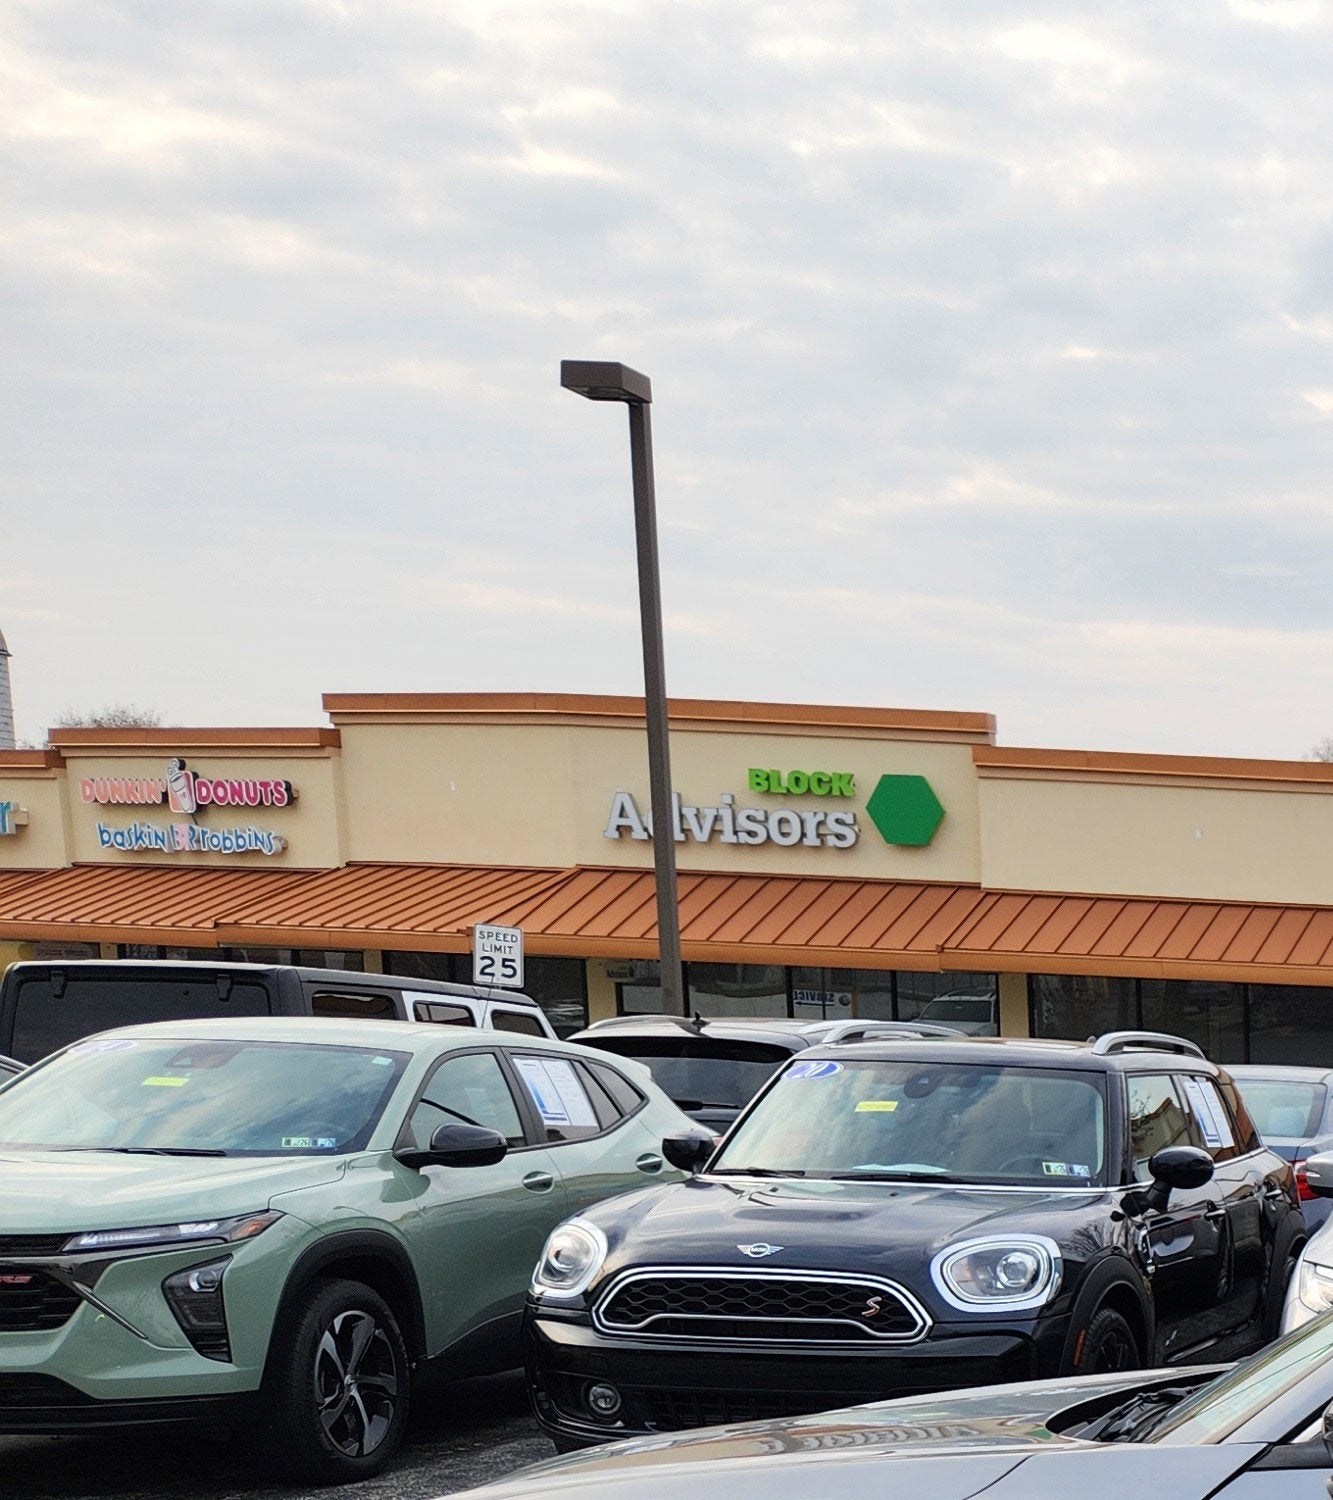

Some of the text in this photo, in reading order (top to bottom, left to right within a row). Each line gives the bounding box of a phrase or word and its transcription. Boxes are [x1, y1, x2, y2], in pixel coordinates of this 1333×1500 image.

[79, 778, 288, 807] DUNKIN' DONUTS
[748, 769, 854, 797] BLOCK
[96, 822, 167, 852] baskin
[199, 826, 275, 856] robbins
[478, 930, 518, 944] SPEED
[482, 943, 514, 955] LIMIT
[479, 956, 518, 979] 25
[862, 1296, 883, 1317] S
